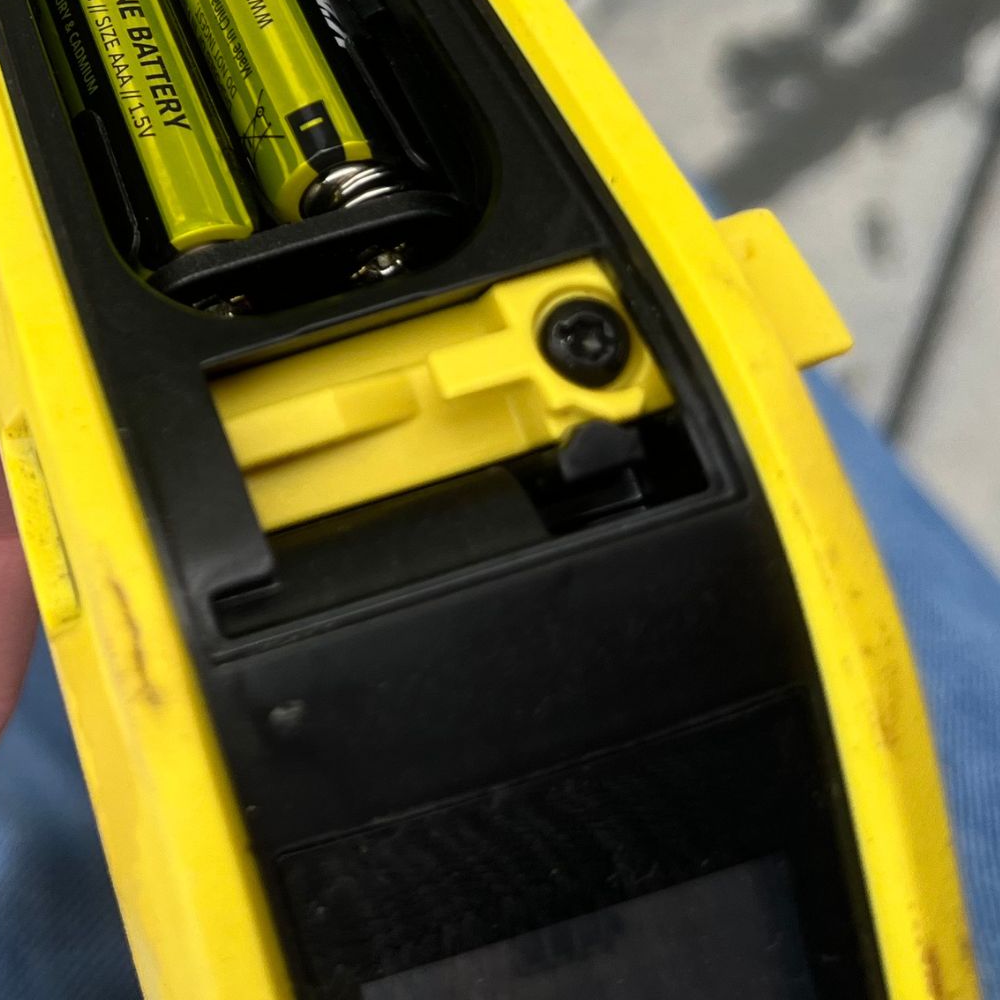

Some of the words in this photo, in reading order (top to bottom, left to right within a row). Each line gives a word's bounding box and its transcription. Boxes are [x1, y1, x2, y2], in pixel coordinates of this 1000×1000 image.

[64, 21, 75, 34] &
[226, 28, 238, 41] in
[68, 32, 99, 96] CADMIUM
[95, 15, 121, 51] SIZE
[108, 53, 134, 89] AAA
[128, 102, 156, 138] 1.5V
[215, 50, 229, 77] NOT
[233, 42, 253, 81] Made
[127, 26, 192, 131] BATTERY
[226, 77, 238, 99] DO
